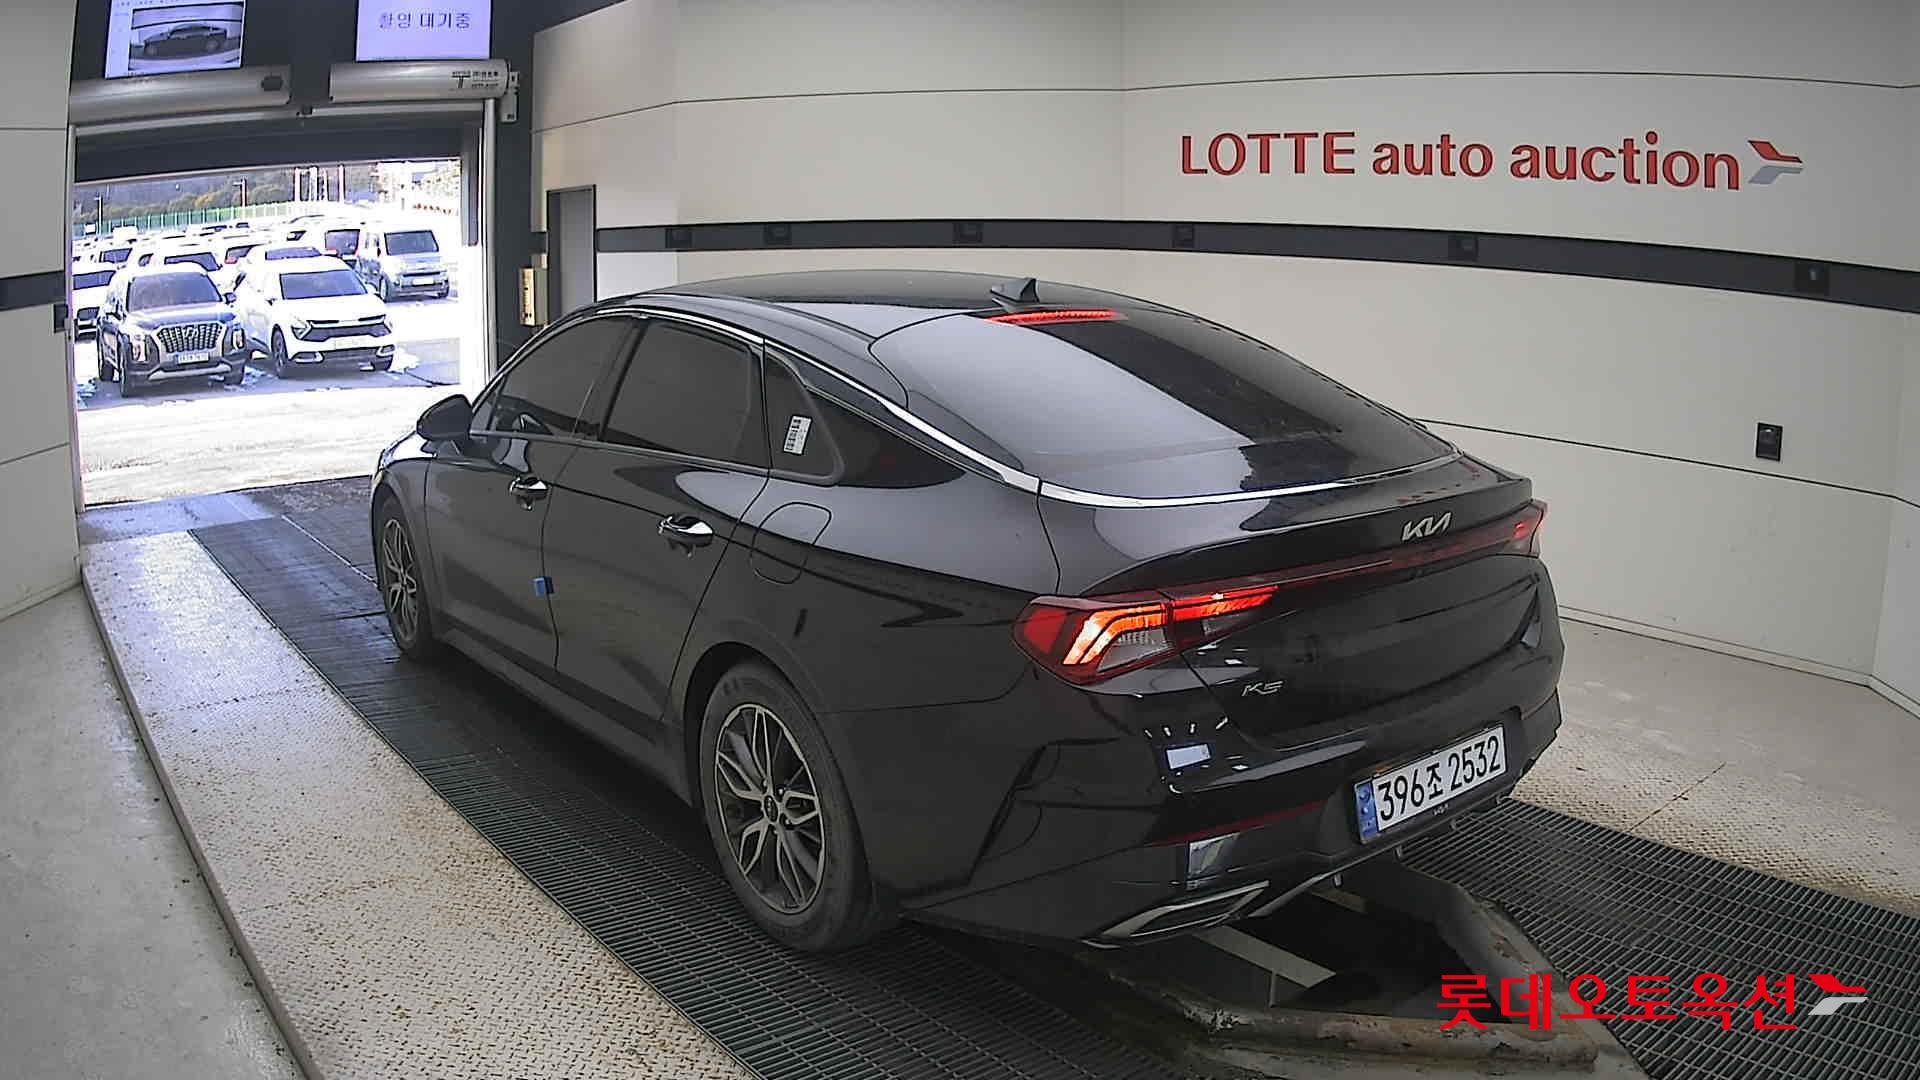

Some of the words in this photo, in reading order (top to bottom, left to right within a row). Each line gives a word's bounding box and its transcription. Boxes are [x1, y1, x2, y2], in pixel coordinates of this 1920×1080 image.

[419, 11, 471, 30] 대기중
[1181, 131, 1356, 176] LOTTE
[1372, 132, 1493, 178] auto
[1509, 130, 1740, 191] auction
[1401, 512, 1452, 541] KIA
[1241, 680, 1283, 697] K5
[1377, 762, 1444, 822] 396조
[1447, 735, 1501, 791] 2532
